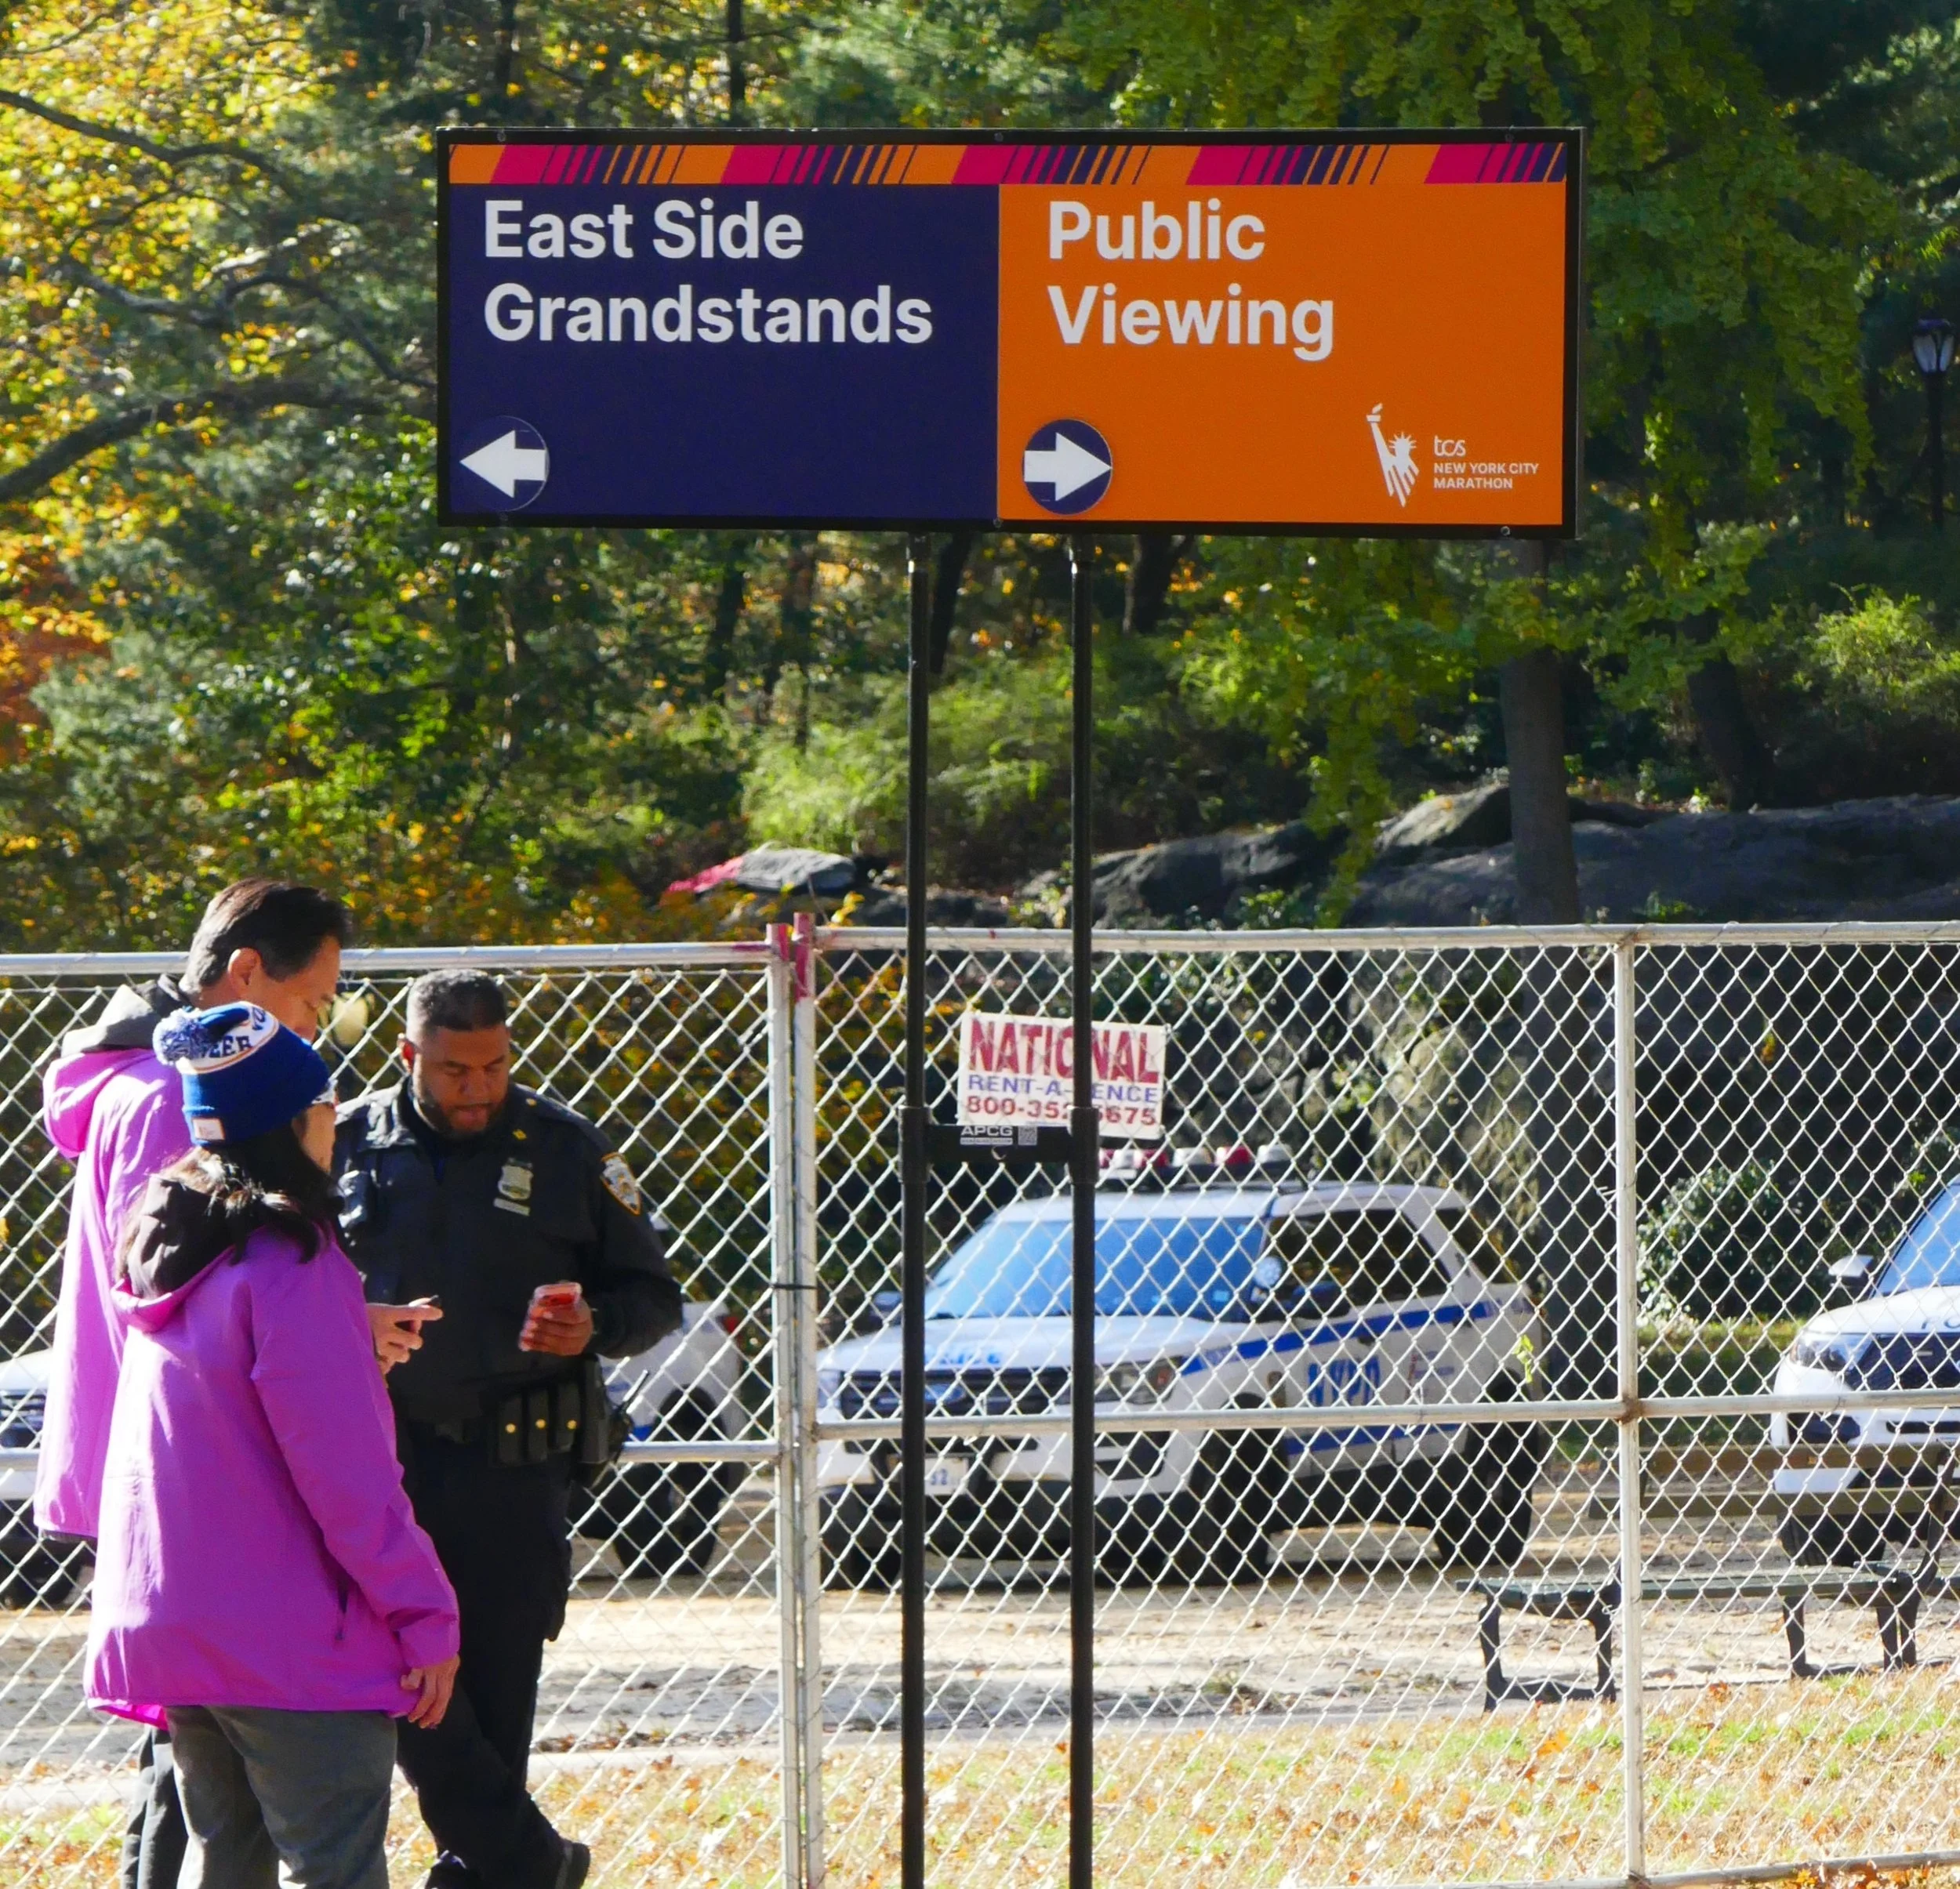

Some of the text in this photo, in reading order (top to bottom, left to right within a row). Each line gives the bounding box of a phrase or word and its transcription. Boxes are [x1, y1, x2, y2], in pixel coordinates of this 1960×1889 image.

[486, 198, 803, 259] East Side
[1050, 198, 1264, 260] Public
[485, 283, 932, 343] Grandstands
[1048, 284, 1333, 361] Viewing
[1434, 436, 1465, 457] tcs
[1434, 463, 1538, 474] NEW YORK CITY
[1434, 477, 1512, 489] MARATHON
[969, 1018, 1160, 1083] NATIONAL
[968, 1075, 1159, 1104] RENT-A-ENCE
[961, 1126, 1013, 1137] APCG
